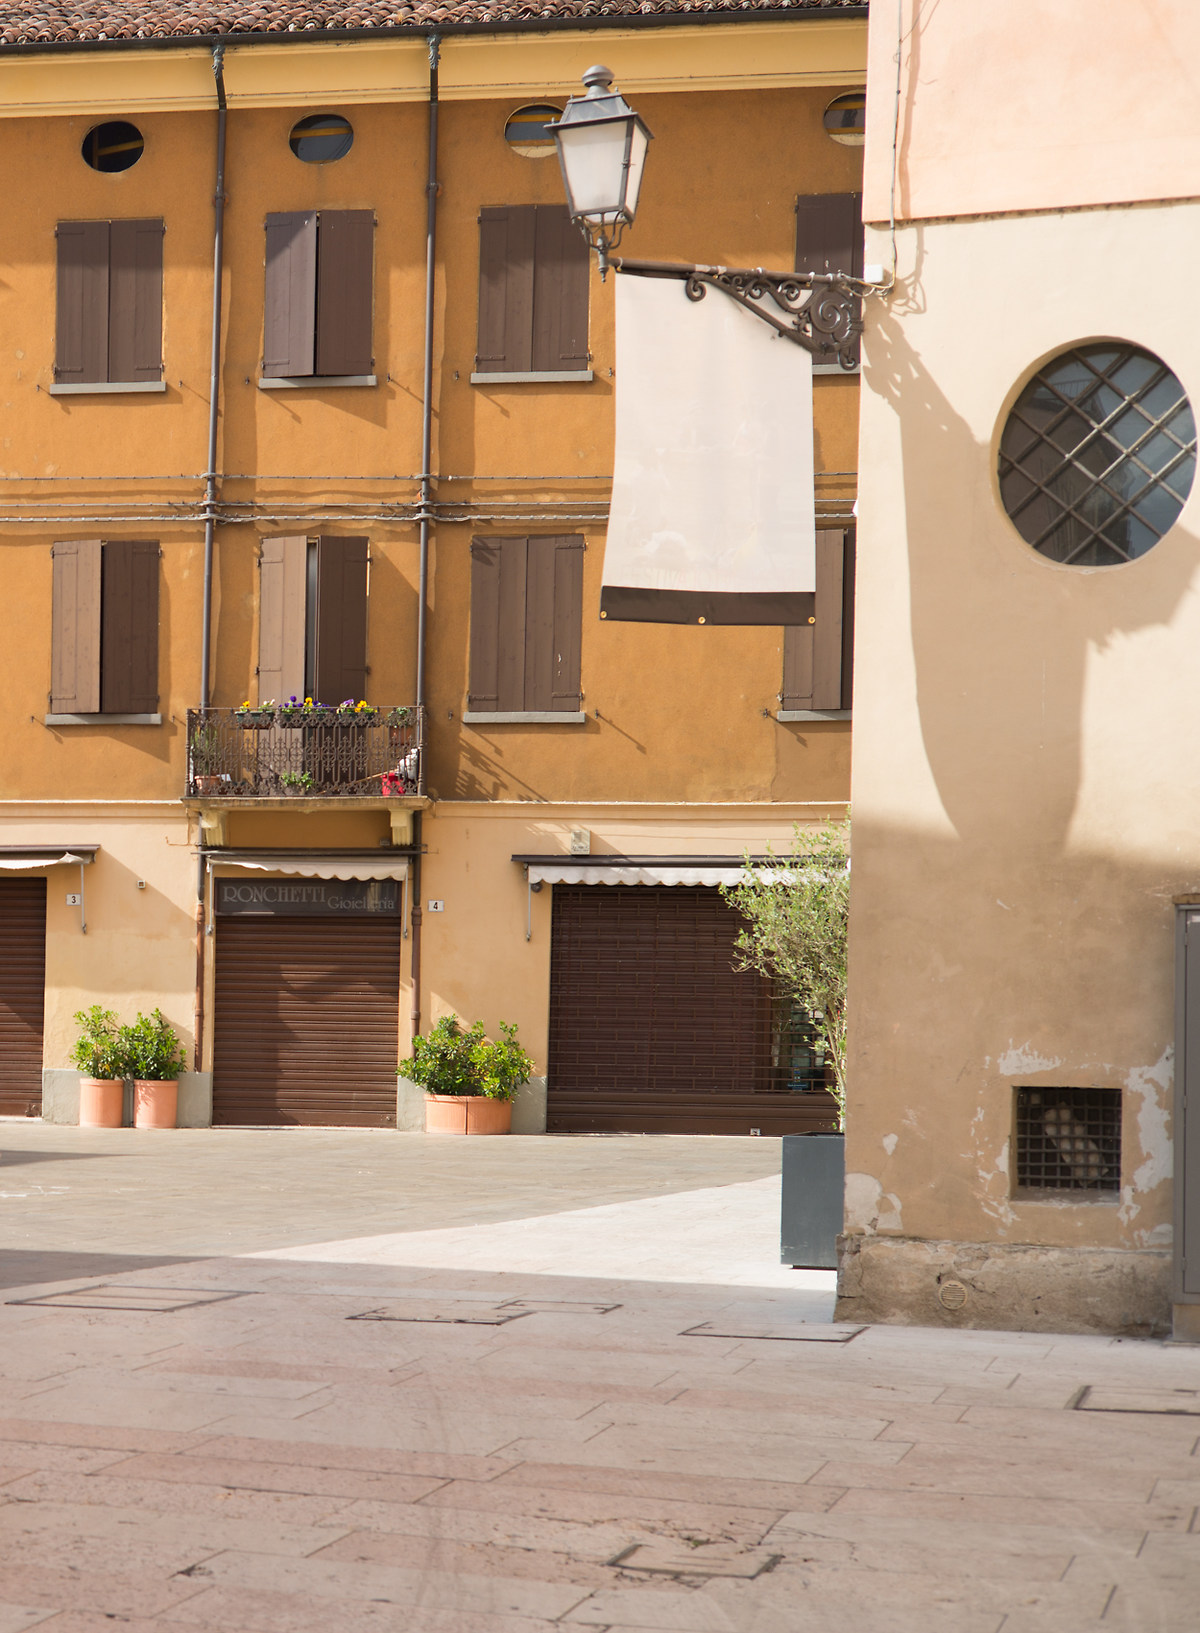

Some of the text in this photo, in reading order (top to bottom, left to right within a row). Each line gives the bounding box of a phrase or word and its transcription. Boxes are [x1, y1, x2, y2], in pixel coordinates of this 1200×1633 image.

[71, 895, 77, 904] 3
[223, 886, 396, 910] RONCHETTI Gioielleria
[433, 901, 439, 910] 4
